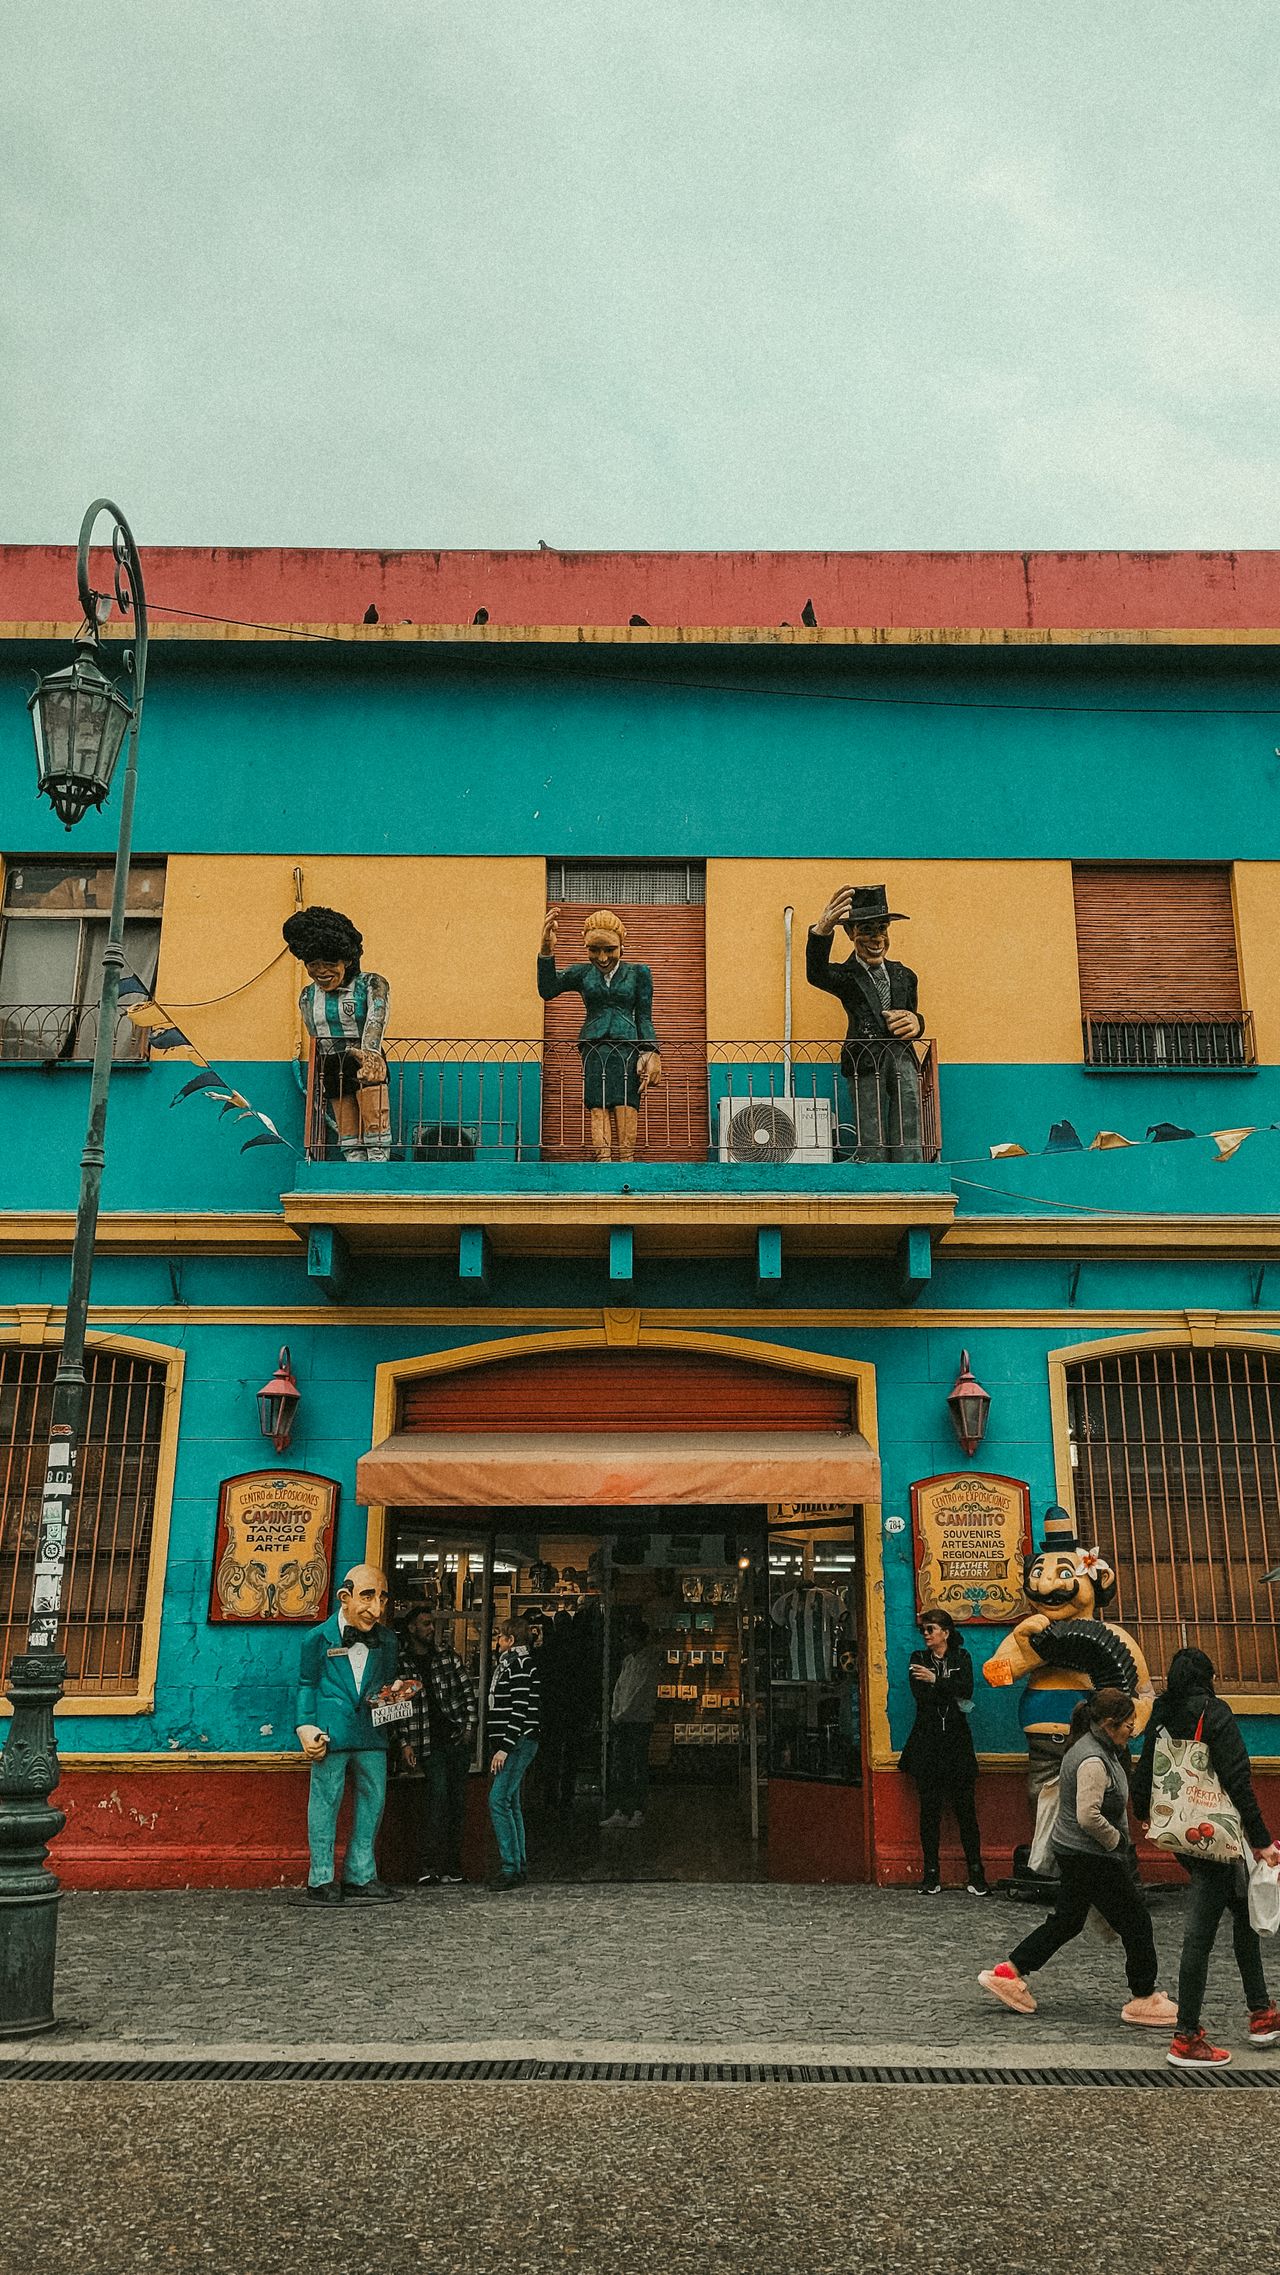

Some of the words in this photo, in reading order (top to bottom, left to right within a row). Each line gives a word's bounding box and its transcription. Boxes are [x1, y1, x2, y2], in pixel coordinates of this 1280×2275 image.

[240, 1491, 265, 1505] CENTRO
[266, 1492, 273, 1500] de
[275, 1490, 319, 1506] EXPOSICIONES
[932, 1493, 956, 1509] CENTRO
[966, 1491, 1011, 1510] EXPOSICIONES
[242, 1510, 312, 1524] CAMINITO
[935, 1512, 1006, 1526] CAMINITO
[249, 1525, 306, 1533] TANGO
[889, 1520, 901, 1530] 784
[943, 1530, 1001, 1538] SOUVENIRS
[254, 1544, 290, 1552] ARTE
[941, 1540, 1005, 1549] ARTESANIAS
[949, 1569, 990, 1577] FACTORY
